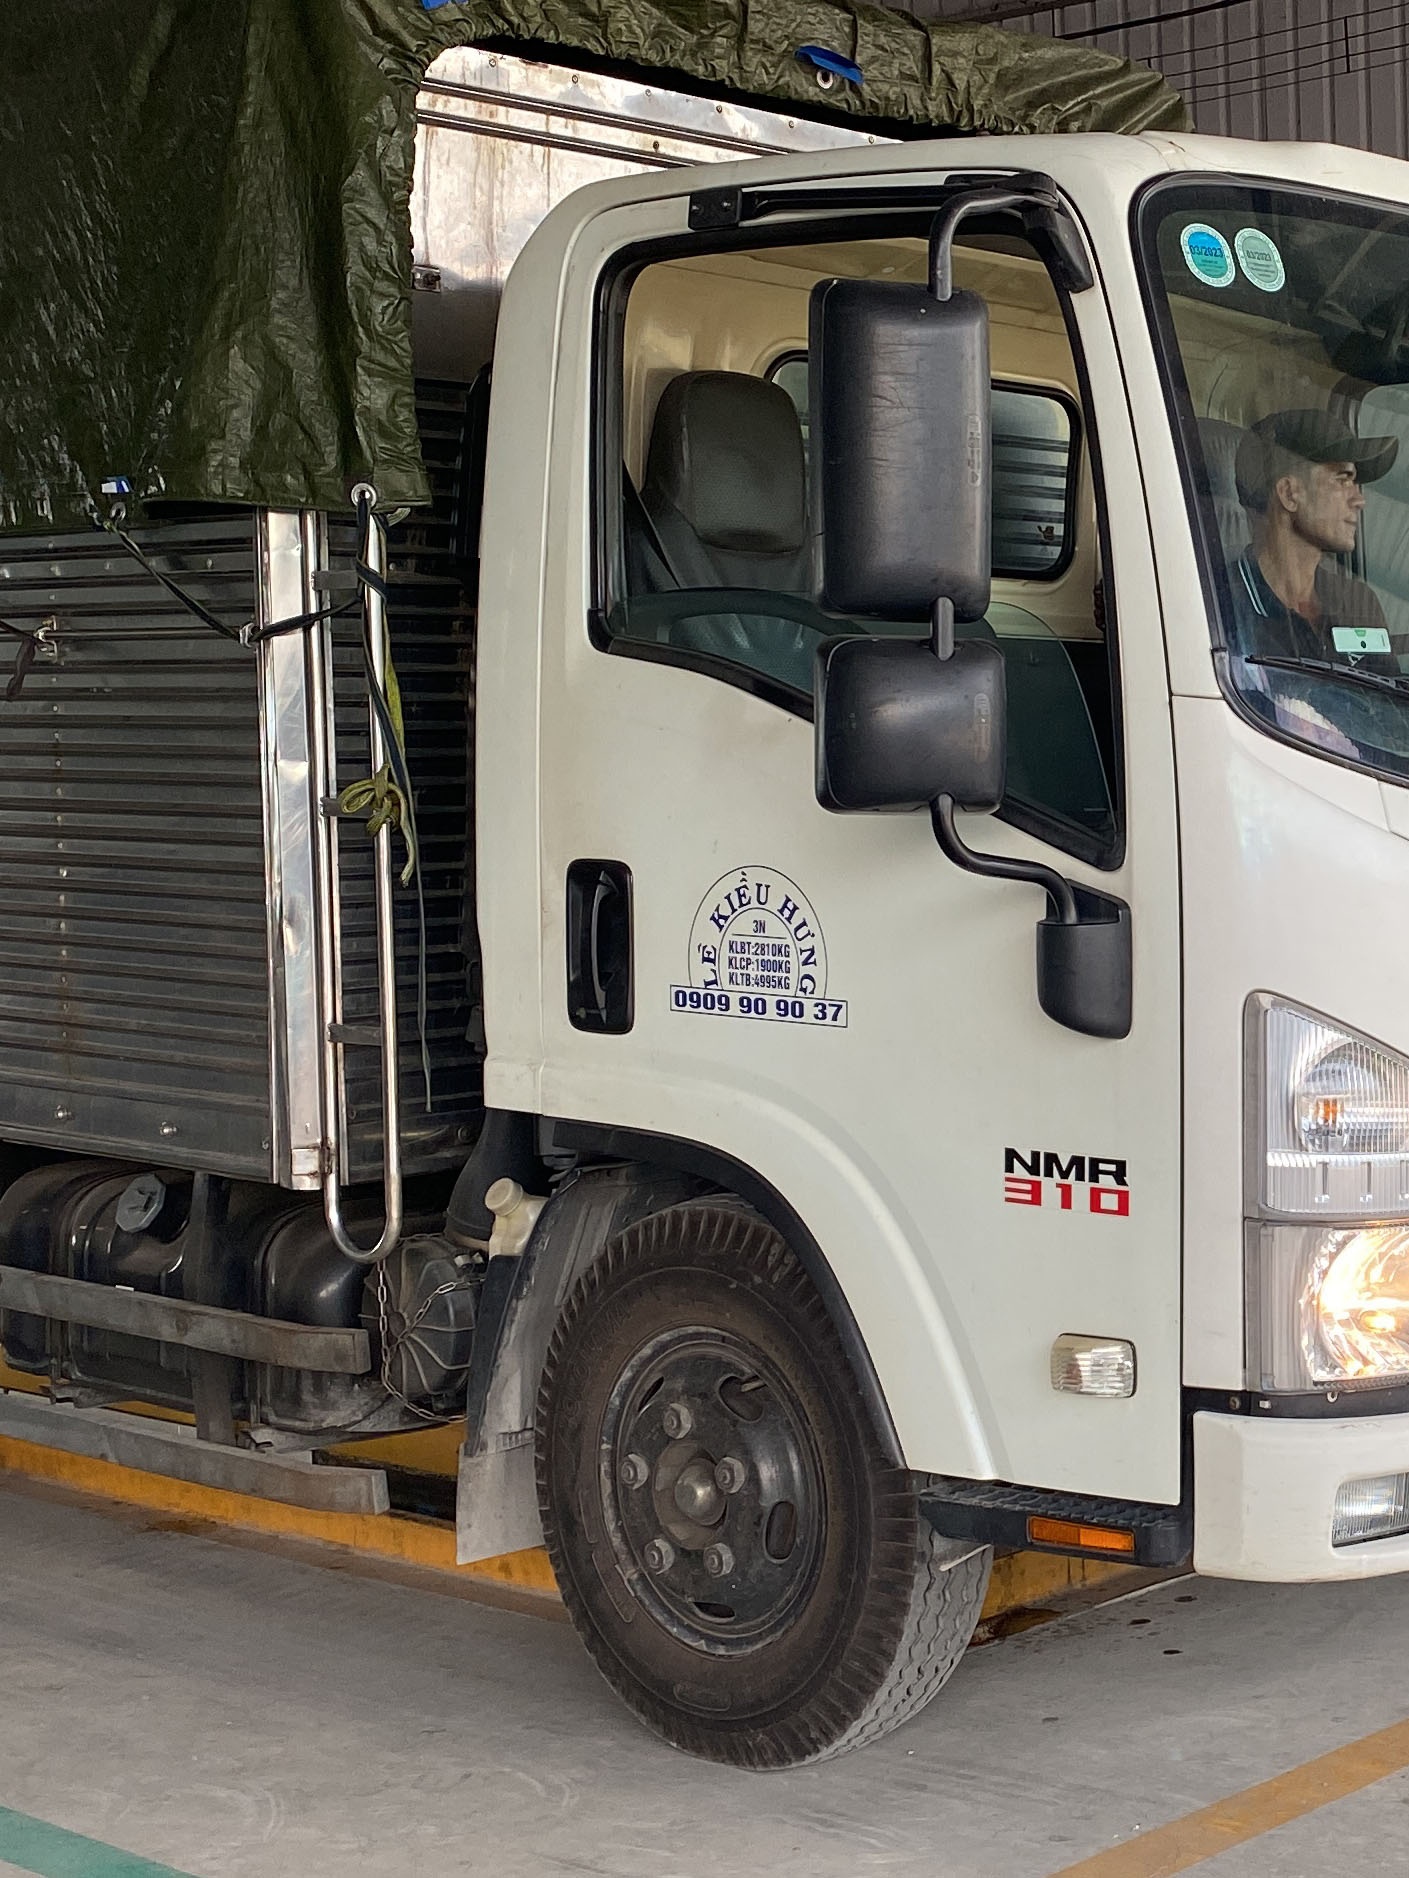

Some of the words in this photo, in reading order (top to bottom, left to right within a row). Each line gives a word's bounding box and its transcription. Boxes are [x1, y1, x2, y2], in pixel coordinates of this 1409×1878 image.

[698, 943, 719, 989] LÊ
[709, 871, 770, 933] KIỀU
[777, 894, 818, 996] HƯNG
[752, 919, 766, 934] 3N
[728, 940, 790, 957] KLBT:2810KG
[728, 956, 791, 974] KLCP:1900KG
[728, 972, 791, 990] KLTB:4995KG
[674, 990, 730, 1012] 0909
[738, 996, 767, 1016] 90
[775, 999, 805, 1019] 90
[813, 1002, 843, 1022] 37
[1004, 1147, 1129, 1187] NMR
[1004, 1177, 1130, 1217] 310
